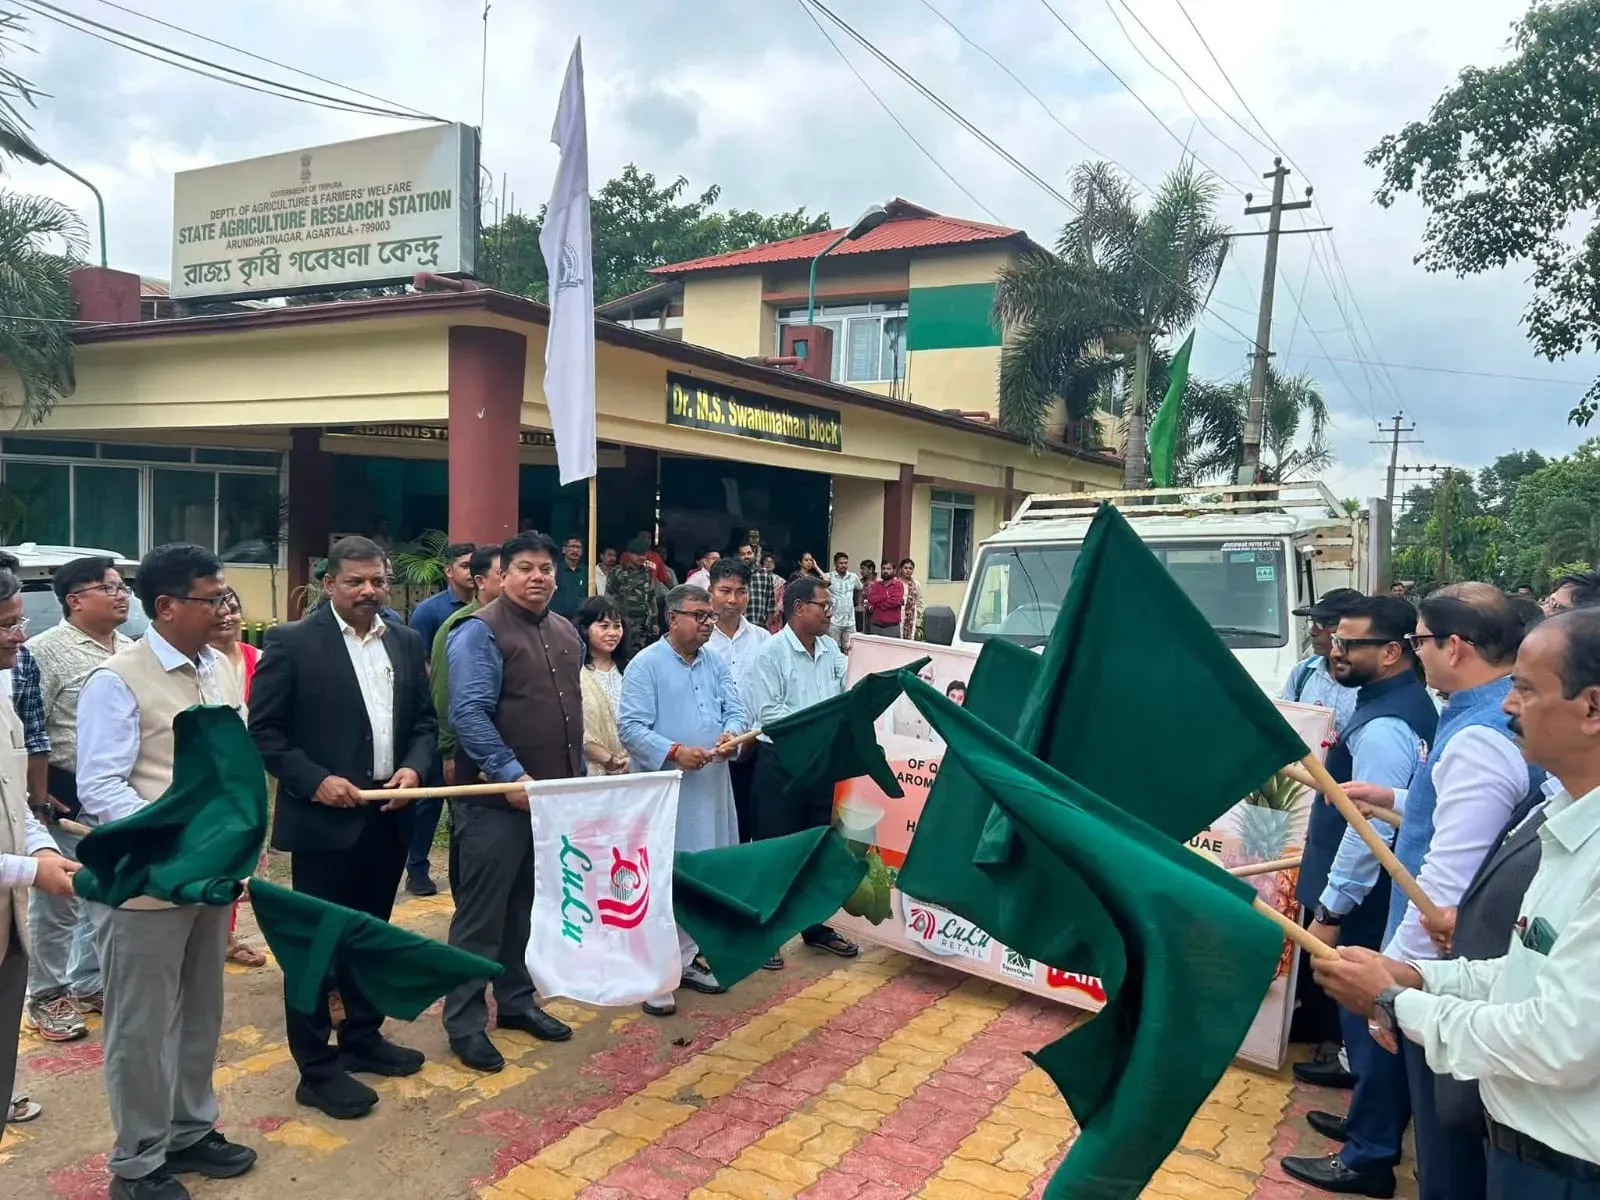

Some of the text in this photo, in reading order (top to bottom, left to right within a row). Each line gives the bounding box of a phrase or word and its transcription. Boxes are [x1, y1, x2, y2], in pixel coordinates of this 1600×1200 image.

[210, 181, 412, 220] DEPTT. OF AGRICULTURE & FARMERS' WELFARE
[270, 181, 343, 199] GOVERNMENT OF TRIPURA
[179, 189, 452, 244] STATE AGRICULTURE RESEARCH STATION
[226, 231, 302, 250] ARUNDHATINAGAR,
[306, 225, 353, 240] AGARTALA
[361, 220, 390, 234] 799003
[183, 260, 232, 287] রাজ্য
[237, 246, 281, 286] কৃষি
[377, 235, 442, 266] কেন্দ্র
[672, 384, 838, 445] Dr. M.S. Swaminathan Block
[908, 758, 925, 770] OF
[896, 771, 934, 788] AROM
[1189, 836, 1222, 853] UAE
[941, 939, 983, 958] RETAIL
